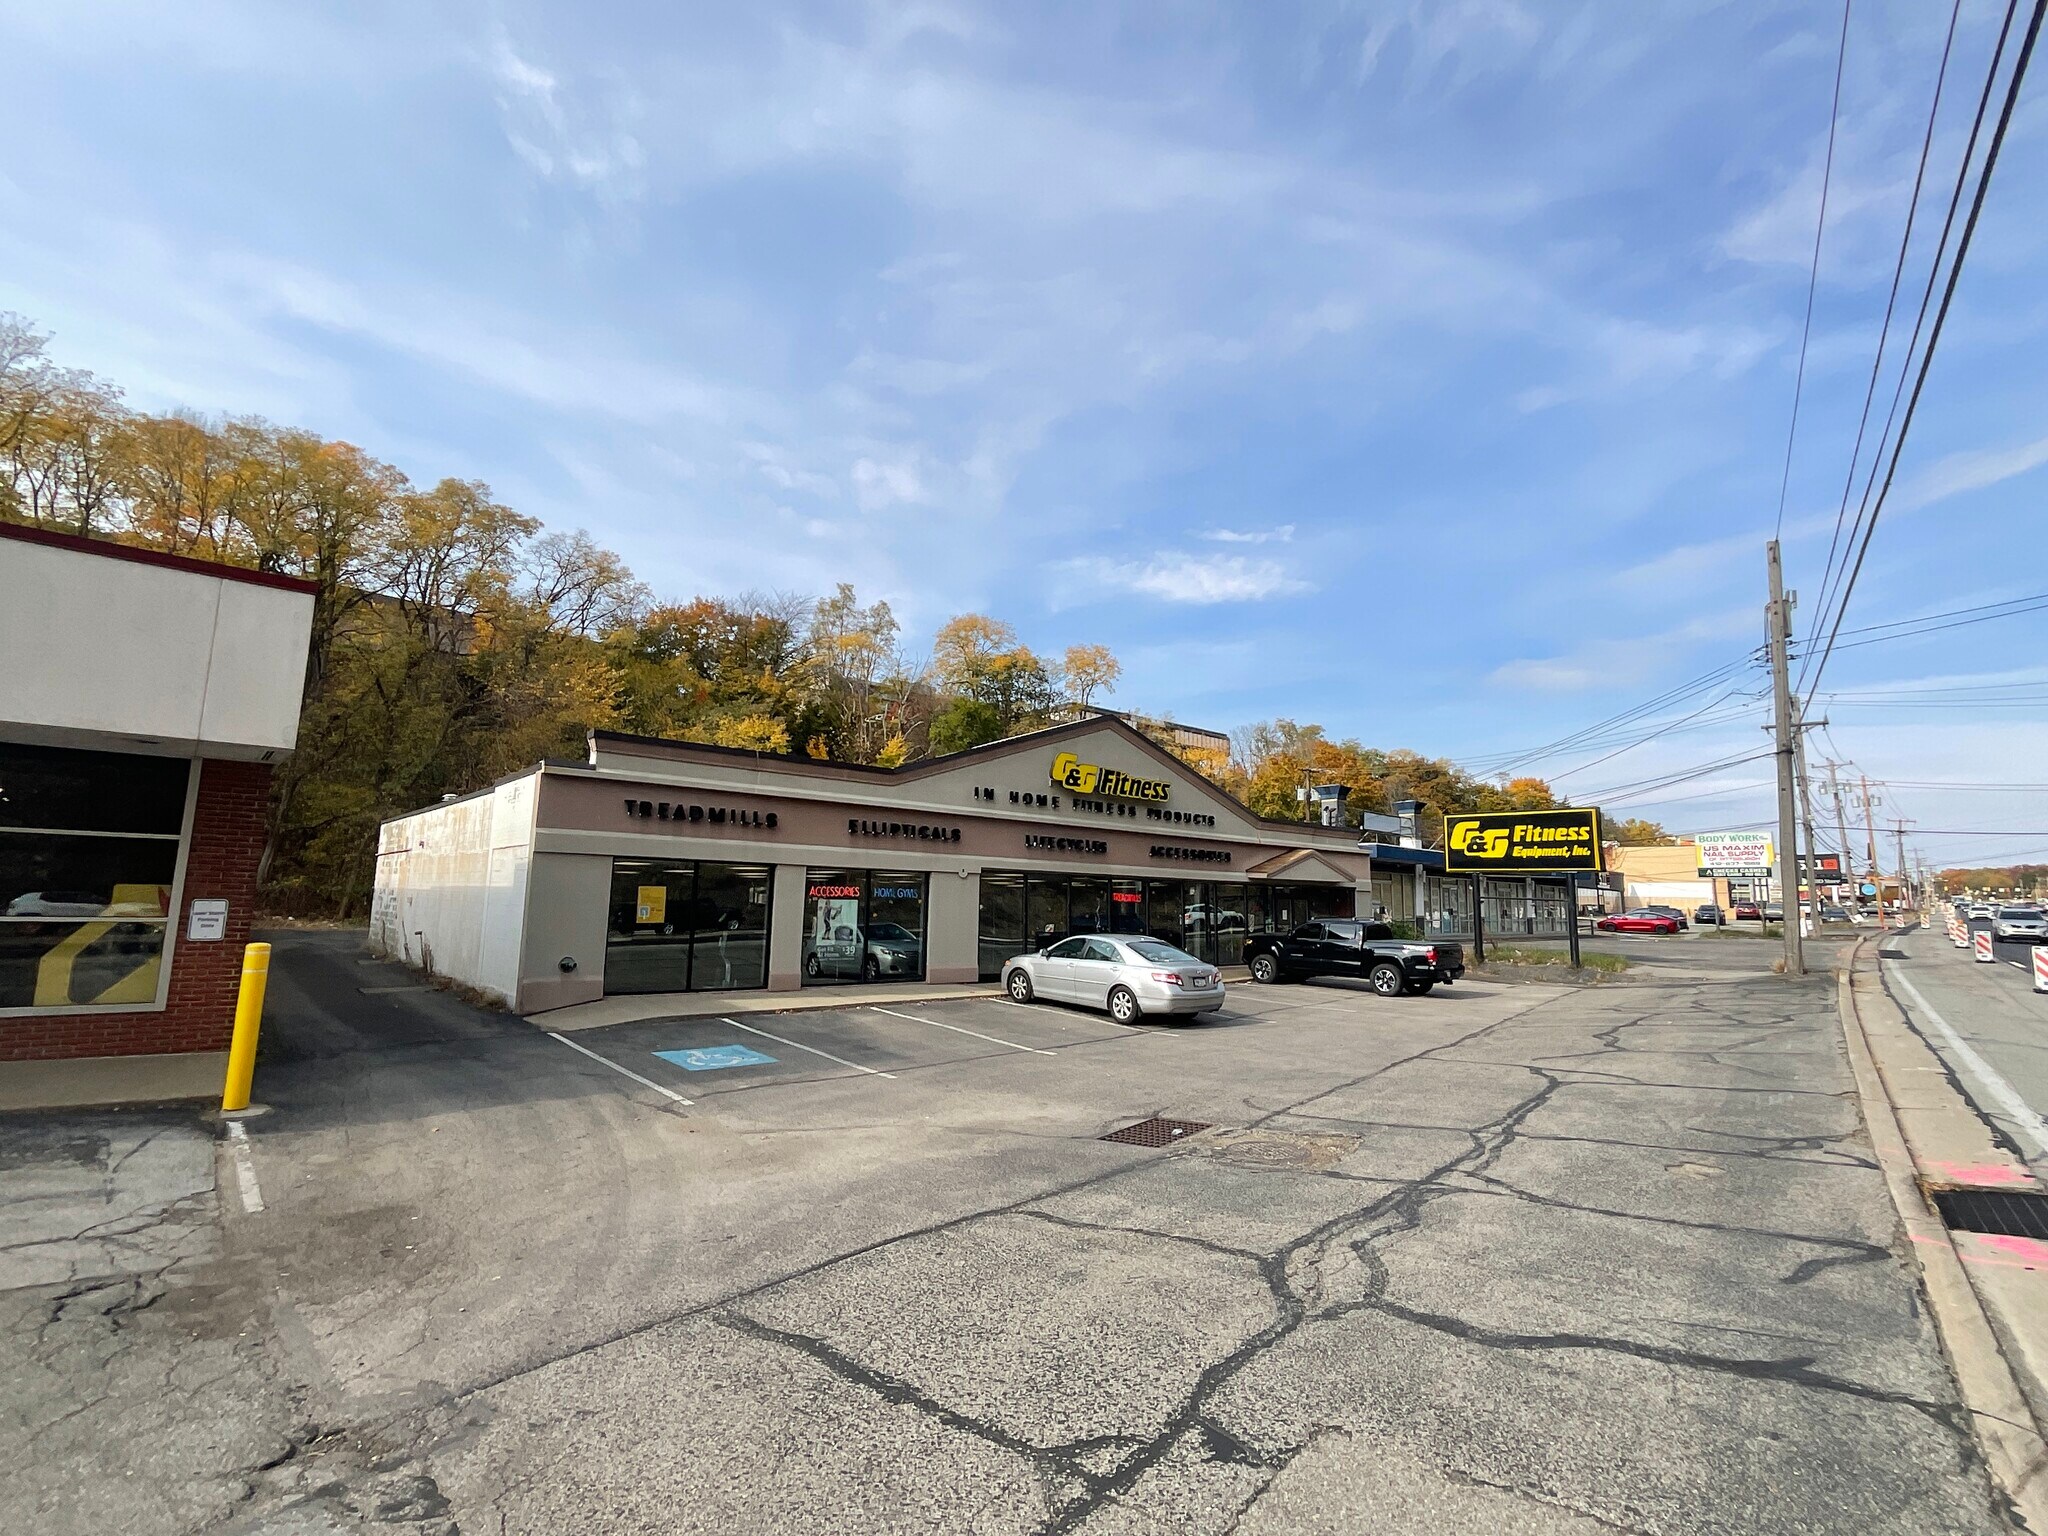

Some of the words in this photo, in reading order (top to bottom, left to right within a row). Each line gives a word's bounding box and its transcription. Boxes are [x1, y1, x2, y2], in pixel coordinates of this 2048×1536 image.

[1099, 768, 1171, 802] Fitness
[624, 799, 778, 829] TREADMILLS
[973, 786, 995, 801] IN
[1008, 790, 1061, 808] HOME
[1072, 798, 1137, 817] FITNESS
[1146, 807, 1216, 827] PRODUCTS
[848, 818, 962, 842] ELLIPTICALS
[1513, 824, 1591, 842] Fitness
[1698, 834, 1727, 843] BODY
[1728, 834, 1760, 843] WORK
[1025, 834, 1108, 854] LIFECYCLES
[1512, 845, 1571, 859] Equipment,
[1571, 844, 1591, 857] Inc.
[1150, 845, 1232, 863] ACCESSORIES
[809, 886, 860, 898] ACCESSORIES
[897, 887, 918, 899] GYMS
